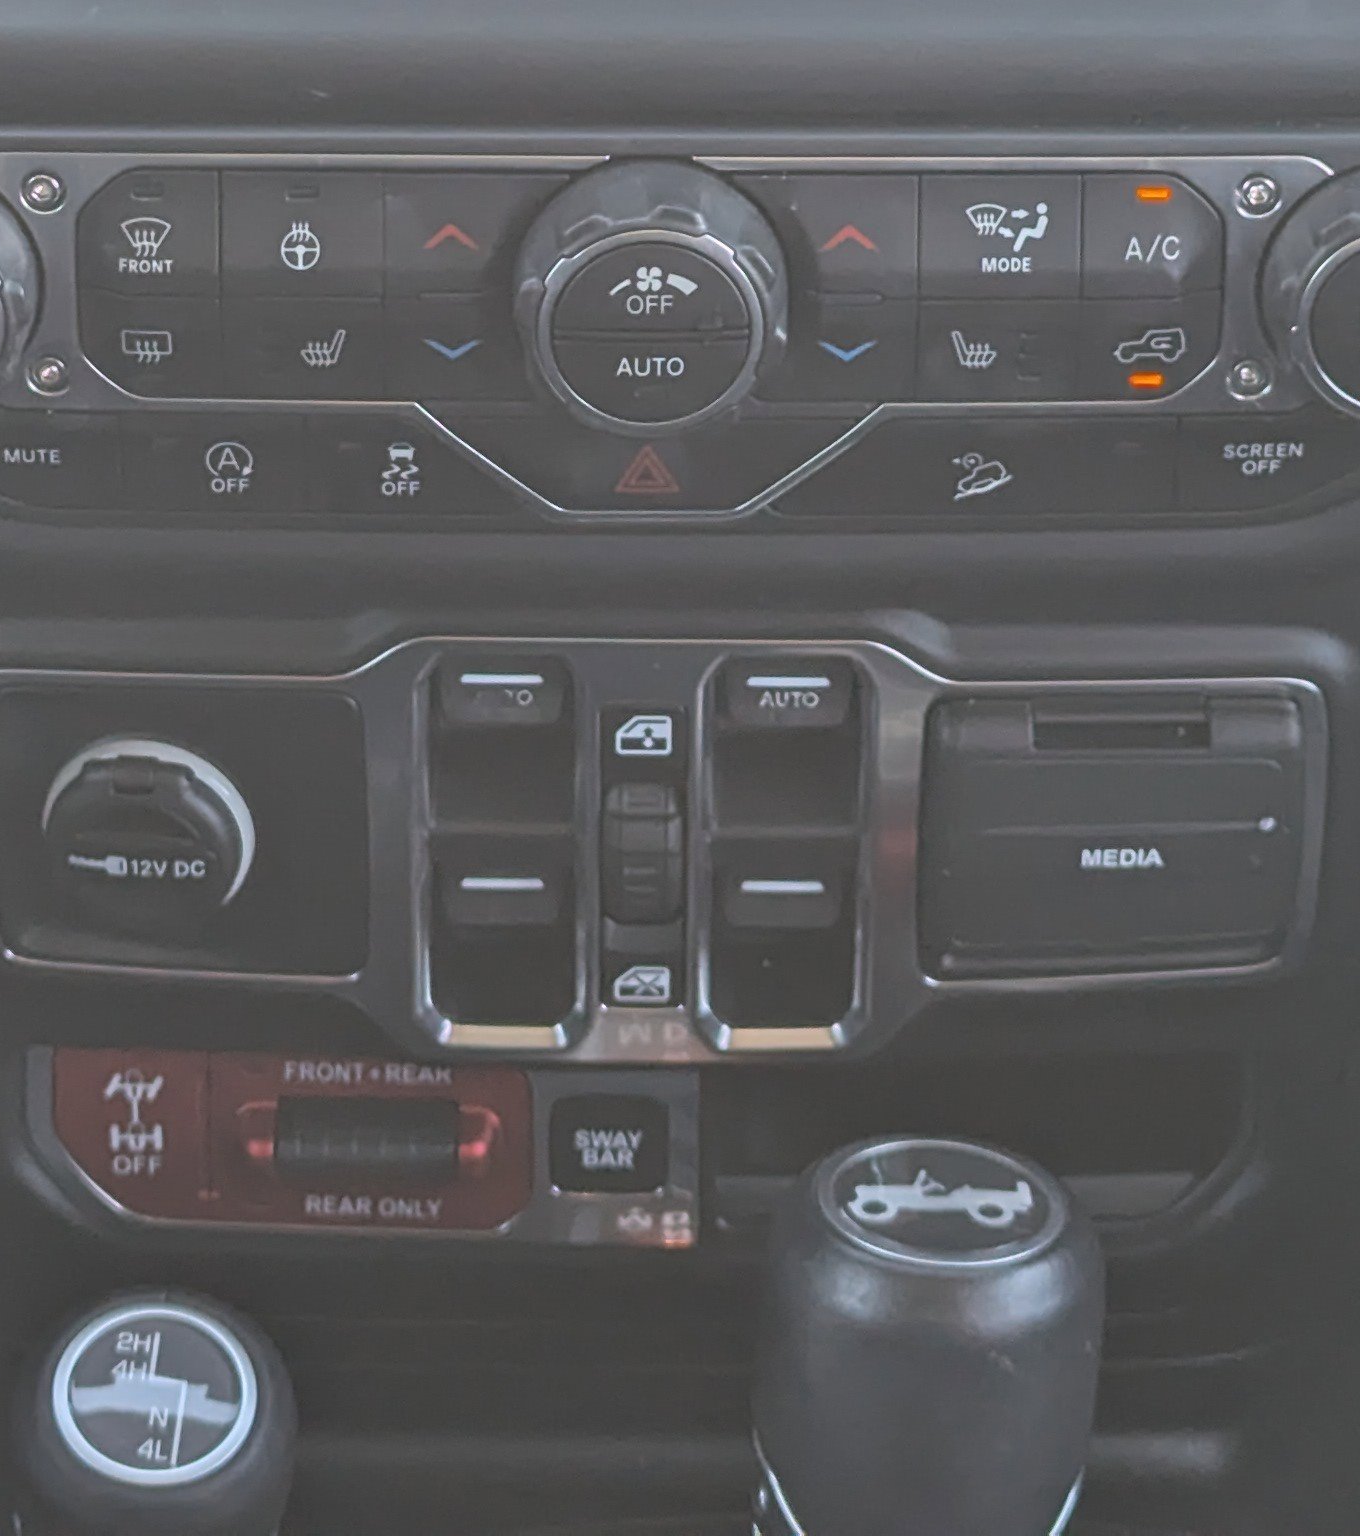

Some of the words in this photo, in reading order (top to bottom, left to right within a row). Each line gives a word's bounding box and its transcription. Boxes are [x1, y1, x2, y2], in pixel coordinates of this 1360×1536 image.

[1125, 236, 1180, 262] A/C
[119, 259, 173, 274] FRONT
[981, 257, 1032, 273] MODE
[627, 295, 673, 315] OFF
[616, 357, 684, 378] AUTO
[3, 448, 61, 464] MUTE
[1224, 443, 1303, 460] SCREEN
[1241, 459, 1282, 475] OFF
[211, 478, 250, 494] OFF
[381, 481, 419, 497] OFF
[759, 691, 819, 709] AUTO
[1080, 848, 1162, 868] MEDIA
[129, 858, 165, 878] 12V
[174, 860, 206, 879] DC
[284, 1061, 363, 1083] FRONT
[574, 1128, 642, 1150] SWAY
[112, 1155, 162, 1175] OFF
[582, 1149, 634, 1170] BAR
[306, 1195, 372, 1215] REAR
[379, 1198, 442, 1219] ONLY
[117, 1332, 151, 1353] 2H
[148, 1407, 169, 1429] N
[138, 1438, 168, 1461] 4L
